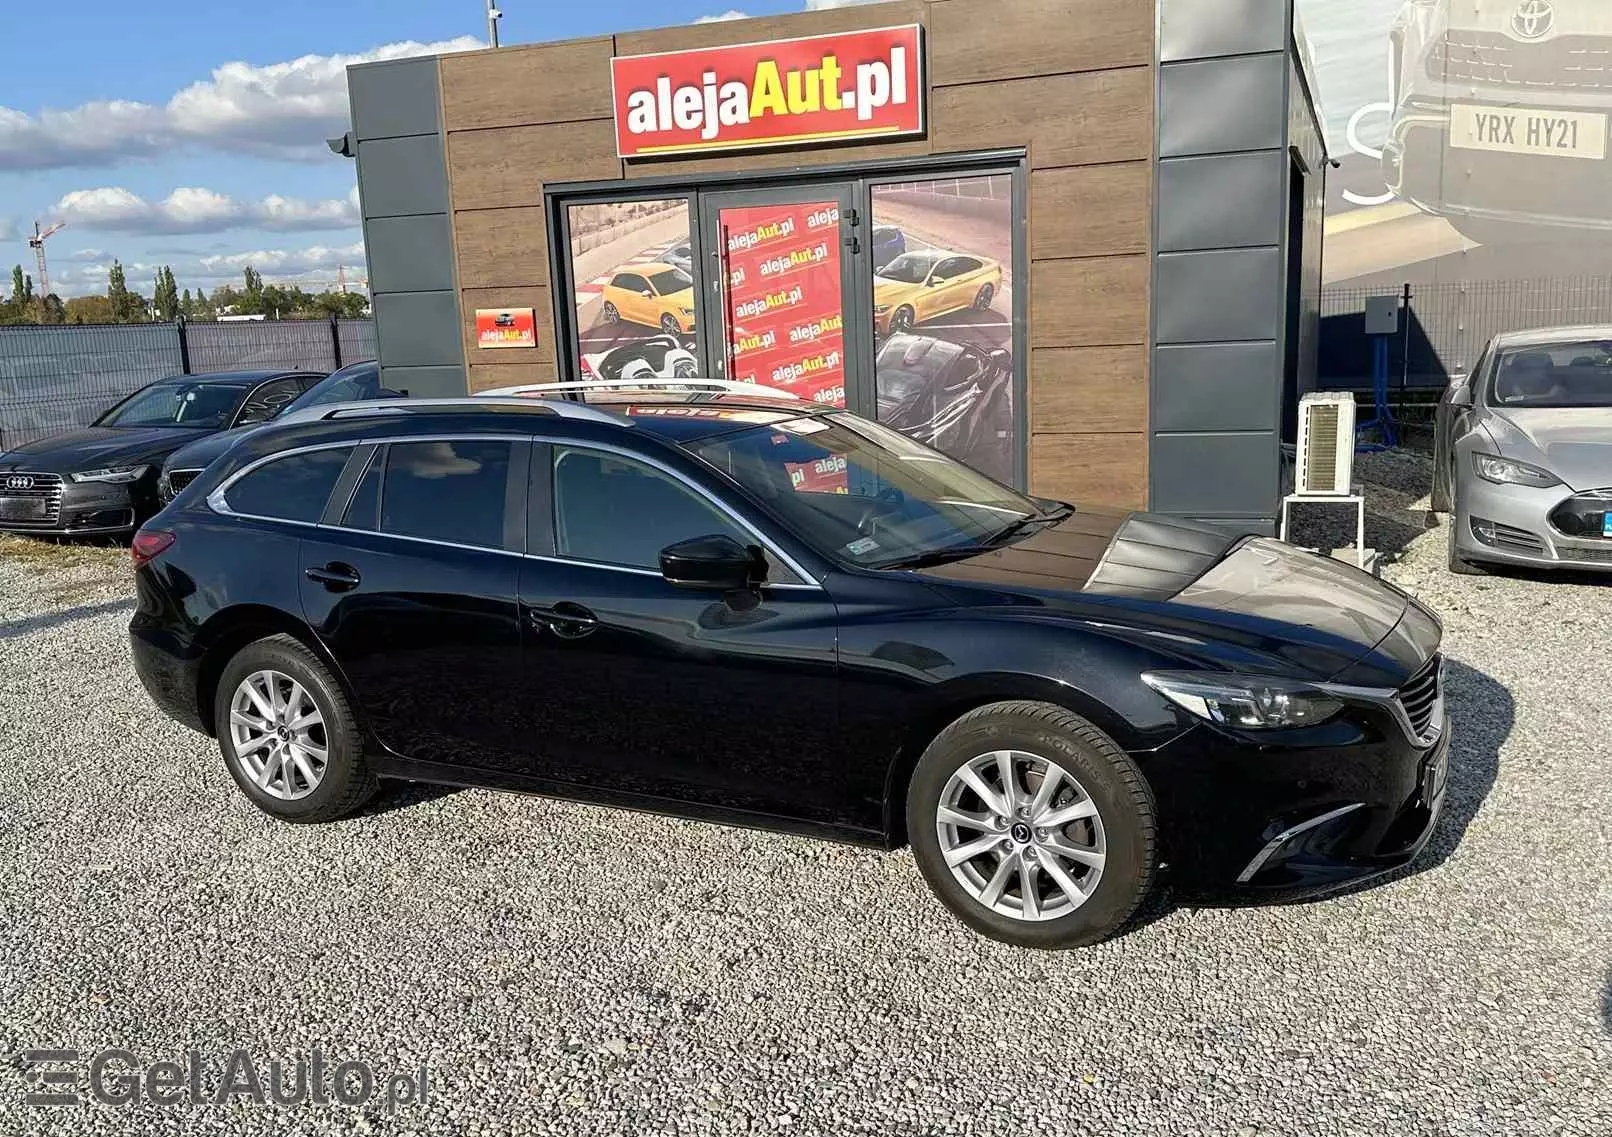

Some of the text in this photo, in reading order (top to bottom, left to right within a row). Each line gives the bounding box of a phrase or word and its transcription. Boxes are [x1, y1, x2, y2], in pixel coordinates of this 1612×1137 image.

[627, 47, 907, 140] alejaAut.pl
[1475, 112, 1578, 150] YRX HY21
[727, 217, 795, 251] alejaAut.pl
[759, 242, 828, 277] alejaAut.pl
[735, 286, 803, 318] alejaAut.pl
[771, 351, 840, 383] alejaAut.pl
